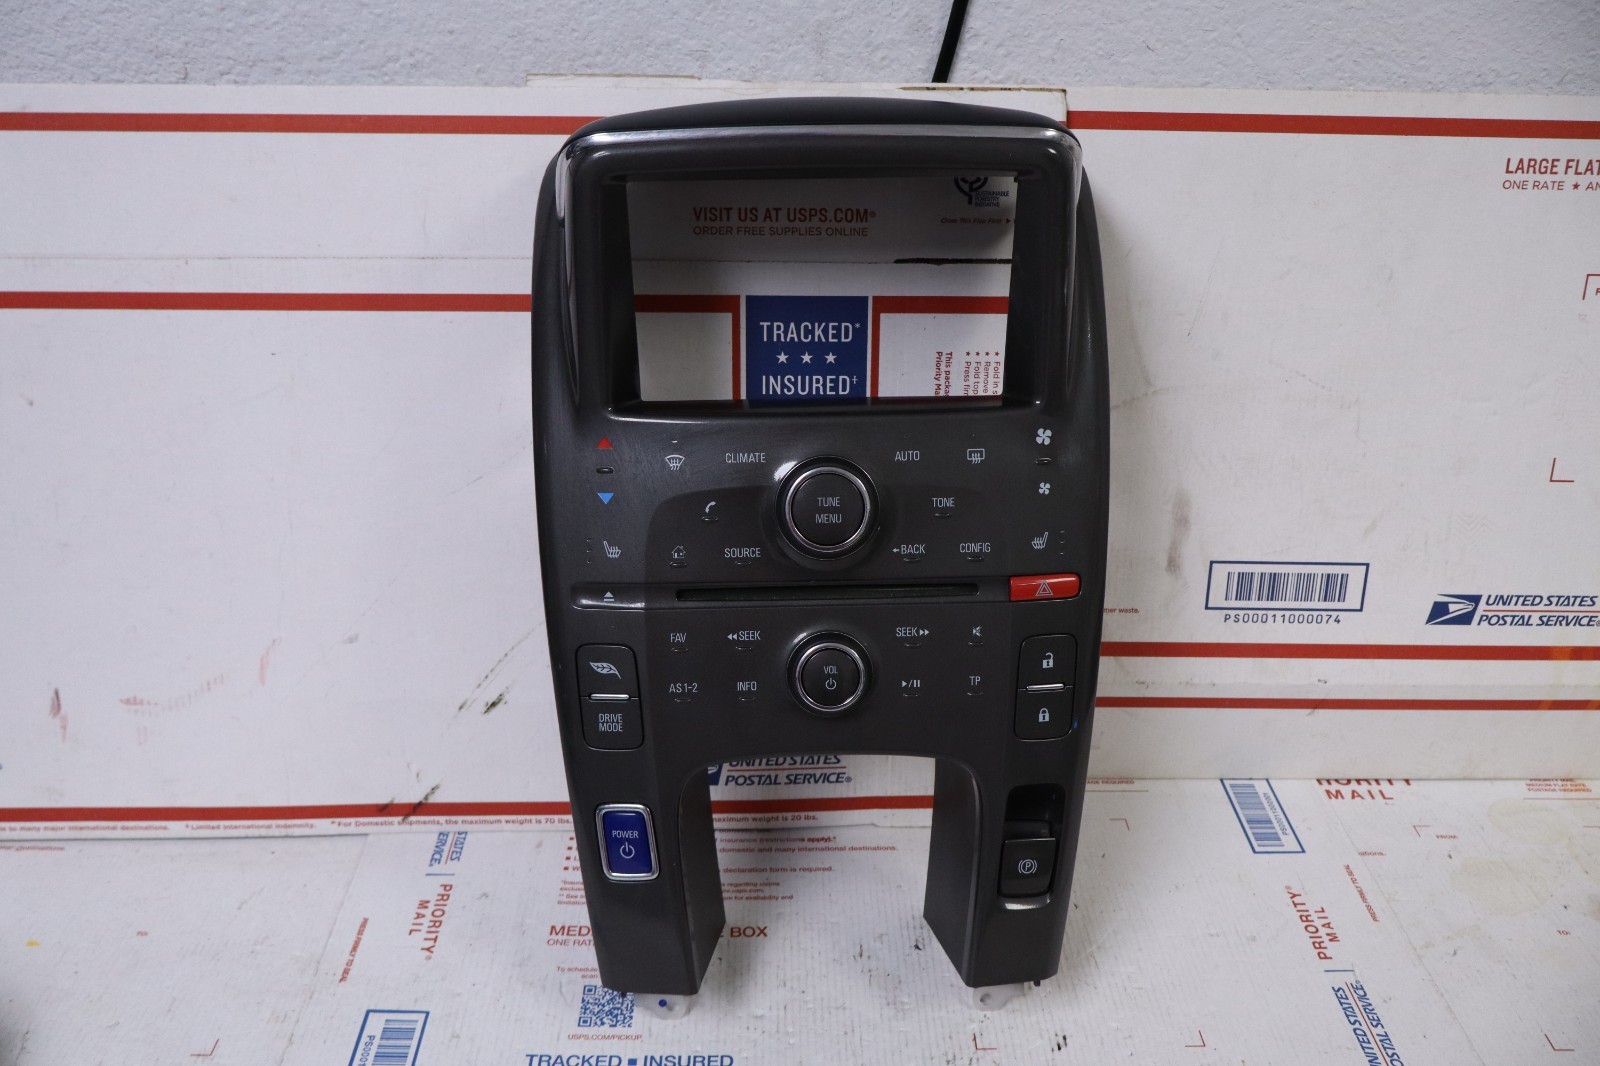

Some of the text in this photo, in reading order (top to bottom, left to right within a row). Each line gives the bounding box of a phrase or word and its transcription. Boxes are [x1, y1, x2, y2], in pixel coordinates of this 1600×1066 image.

[1505, 157, 1560, 175] LARGE
[1502, 179, 1529, 190] ONE
[1532, 180, 1565, 191] RATE
[692, 206, 733, 223] VISIT
[737, 207, 758, 223] US
[762, 207, 782, 223] AT
[693, 226, 869, 237] ORDER FREE SUPPLIES ONLINE
[945, 351, 953, 369] This
[933, 351, 943, 382] Priority
[964, 361, 972, 383] Press
[993, 361, 1001, 379] Fold
[972, 361, 982, 395] Fold top
[983, 361, 991, 394] Remove
[725, 452, 766, 464] CLIMATE
[894, 450, 920, 461] AUTO
[817, 496, 841, 507] TUNE
[932, 497, 955, 508] TONE
[815, 513, 842, 524] MENU
[724, 547, 761, 558] SOURCE
[901, 543, 926, 555] BACK
[959, 542, 991, 553] CONFIG
[1485, 594, 1599, 607] UNITED STATES
[1224, 613, 1342, 625] PS00011000074
[1477, 614, 1534, 627] POSTAL
[670, 632, 687, 643] FAV
[738, 630, 761, 641] SEEK
[896, 627, 918, 637] SEEK
[823, 665, 838, 675] VOL
[737, 681, 757, 691] INFO
[969, 675, 981, 686] TP
[598, 713, 623, 723] DRIVE
[598, 723, 623, 733] MODE
[788, 755, 842, 767] STATES
[724, 774, 782, 787] POSTAL
[1325, 789, 1394, 800] MAIL
[355, 819, 395, 827] Domestic
[461, 817, 502, 825] maximum
[504, 817, 533, 826] weight
[535, 817, 542, 825] is
[544, 817, 555, 825] 70
[752, 815, 779, 823] weight
[804, 813, 819, 821] lbs.
[611, 830, 639, 839] POWER
[757, 845, 773, 853] and
[775, 846, 796, 855] many
[797, 845, 847, 853] international
[723, 865, 768, 874] declaration
[769, 865, 788, 873] form
[408, 899, 431, 936] MAIL
[1314, 906, 1341, 942] MAIL
[729, 926, 768, 938] BOX
[546, 938, 570, 946] ONE
[1332, 986, 1363, 1027] STATES
[525, 1054, 735, 1066] TRACKED INSURED
